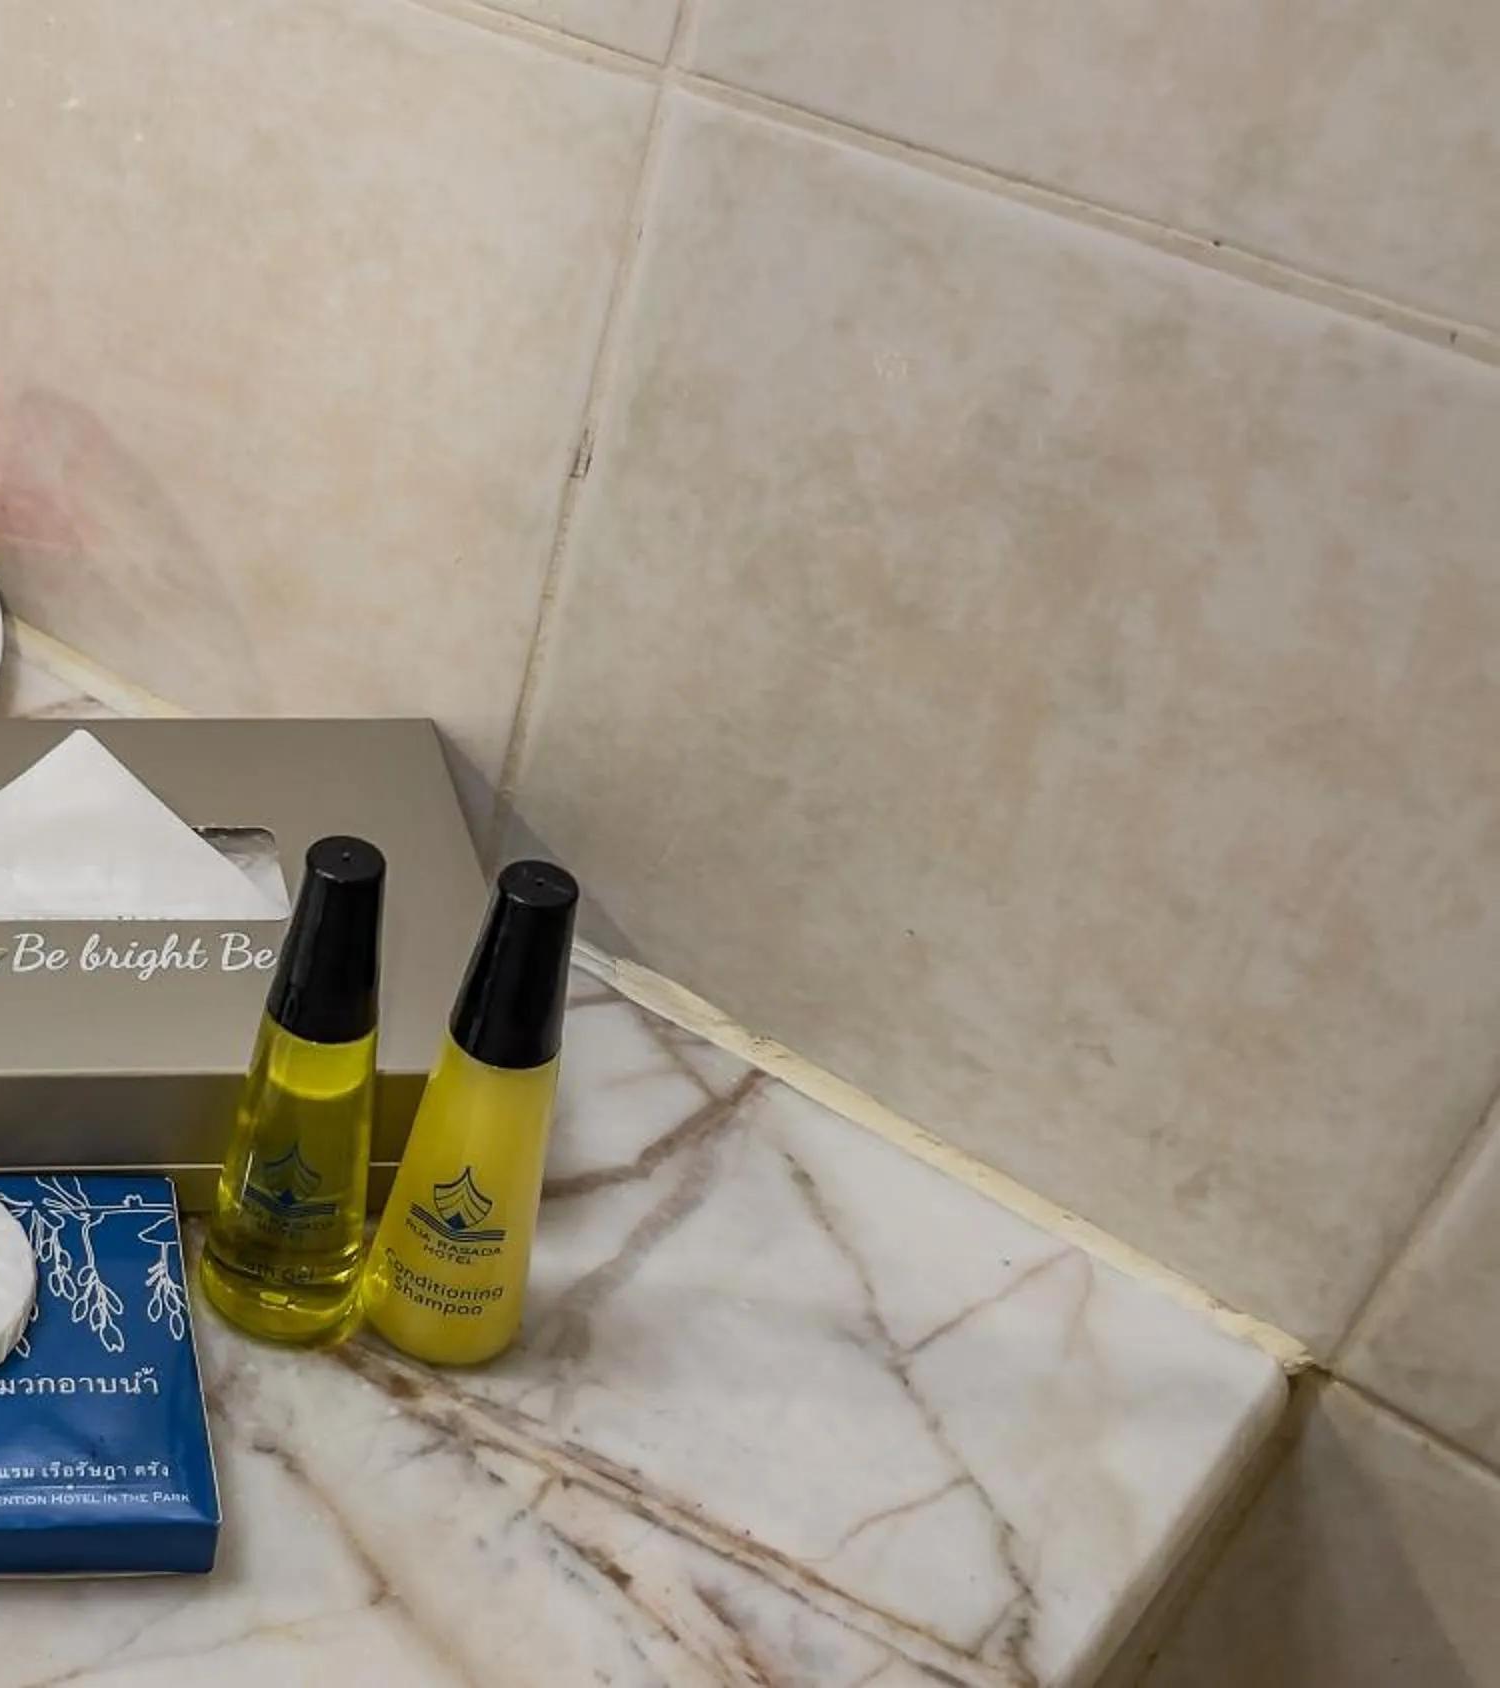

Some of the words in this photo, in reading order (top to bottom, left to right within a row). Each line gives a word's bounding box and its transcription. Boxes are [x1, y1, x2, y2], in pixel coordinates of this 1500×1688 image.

[13, 933, 69, 972] Be
[80, 933, 208, 980] bright
[220, 932, 276, 971] Be
[393, 1275, 485, 1317] Shampoo
